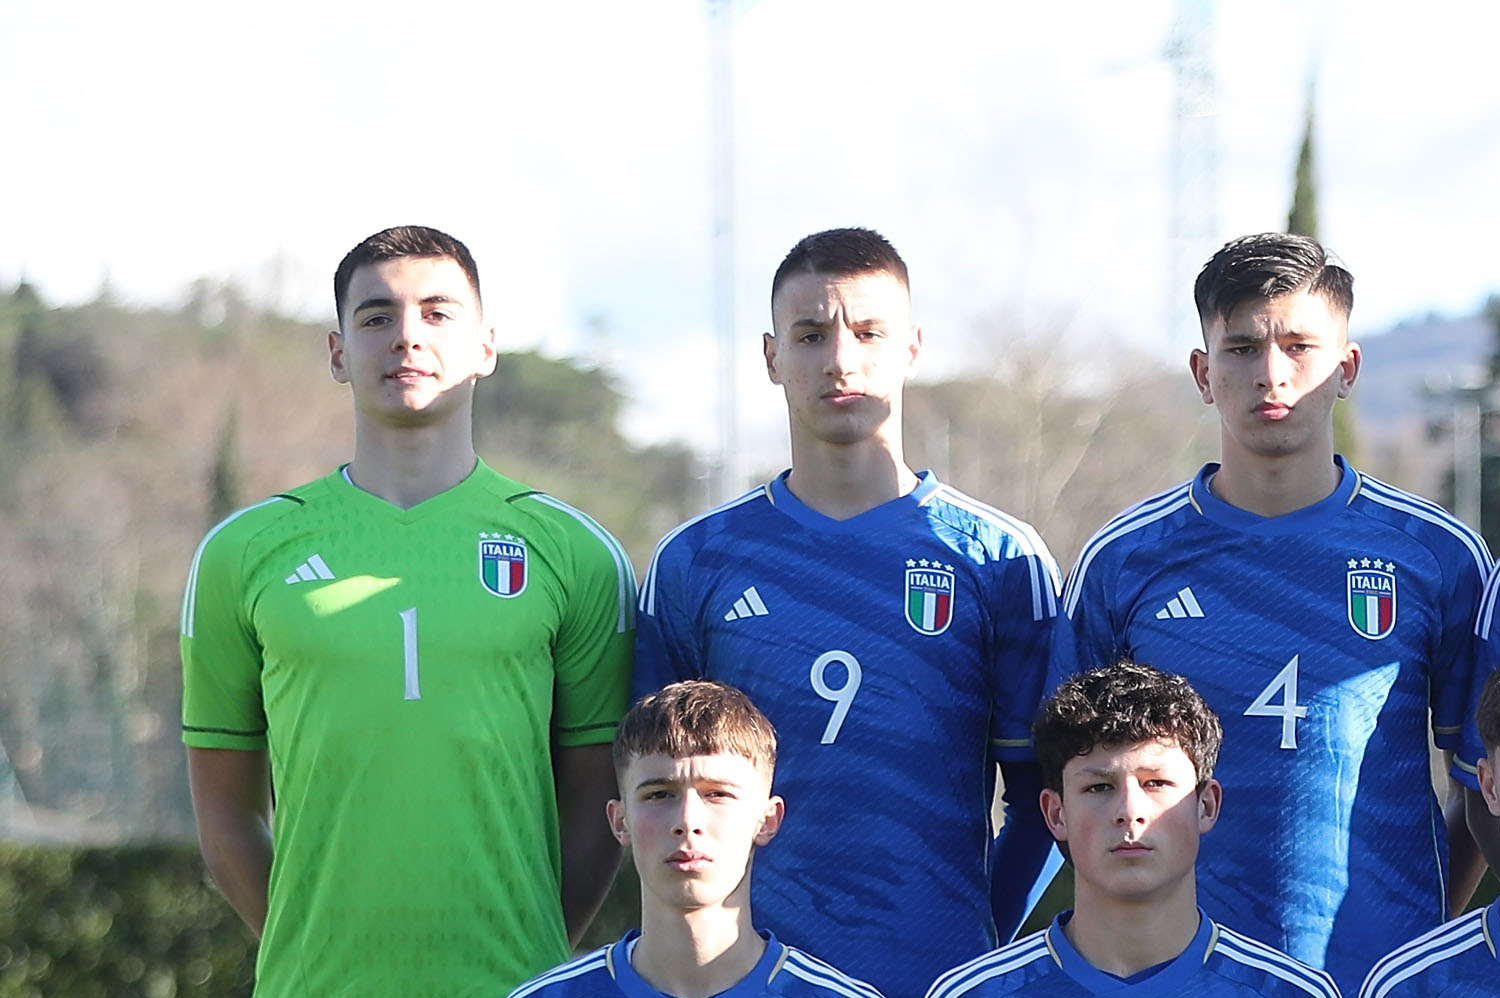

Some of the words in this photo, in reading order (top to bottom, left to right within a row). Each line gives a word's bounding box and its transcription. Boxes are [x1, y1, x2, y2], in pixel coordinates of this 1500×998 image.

[483, 544, 523, 557] ITALIA
[911, 574, 950, 589] ITALIA
[1352, 576, 1391, 591] ITALIA
[399, 607, 421, 700] 1
[810, 650, 862, 744] 9
[1242, 654, 1307, 749] 4
